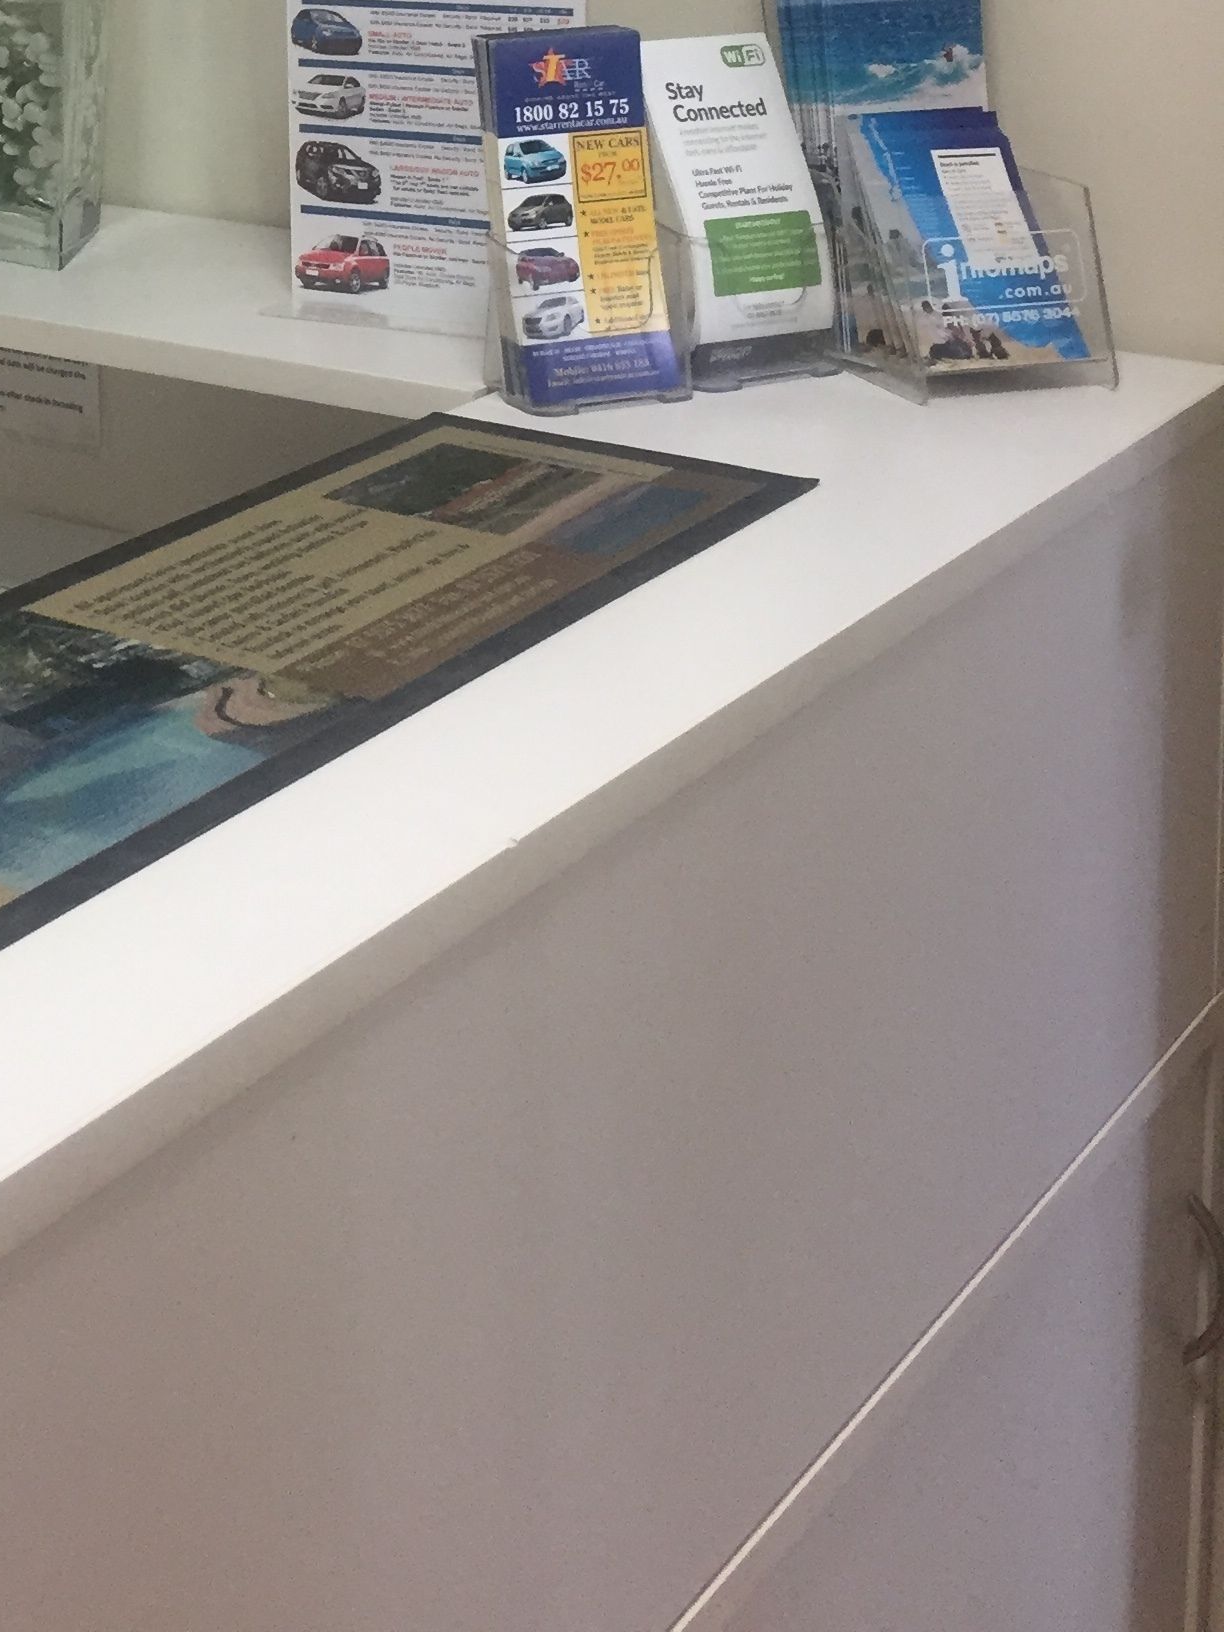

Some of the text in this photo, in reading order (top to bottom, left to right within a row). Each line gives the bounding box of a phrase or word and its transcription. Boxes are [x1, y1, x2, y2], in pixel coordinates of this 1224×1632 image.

[665, 82, 703, 101] Stay
[514, 98, 629, 123] 1800 82 15 75
[673, 97, 767, 123] Connected
[516, 116, 628, 133] www.starrentacar.com.au
[577, 136, 639, 150] NEW CARS
